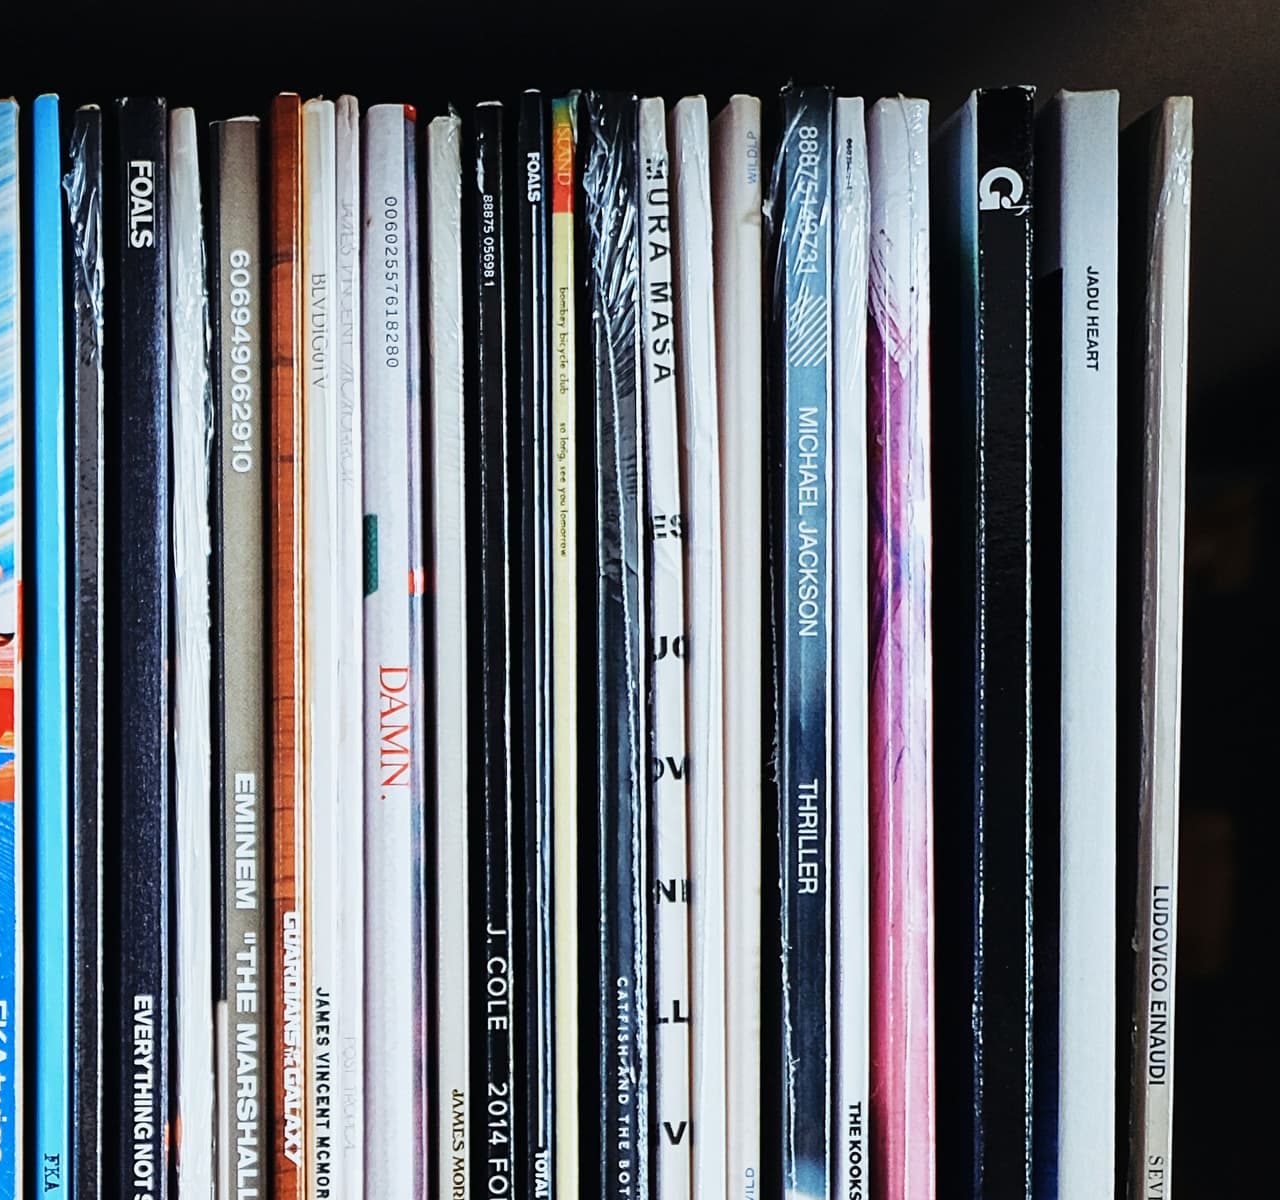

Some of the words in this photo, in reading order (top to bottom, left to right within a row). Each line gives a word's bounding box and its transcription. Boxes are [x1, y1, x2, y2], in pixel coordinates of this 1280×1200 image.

[130, 161, 152, 247] FOALS
[385, 197, 399, 367] 00602557618280
[1087, 266, 1099, 310] JADU
[231, 250, 251, 471] 606949062910
[1087, 316, 1099, 371] HEART
[799, 407, 817, 514] MICHAEL
[799, 520, 817, 635] JACKSON
[380, 665, 410, 800] DAMN.
[487, 922, 507, 944] J.
[1151, 885, 1169, 992] LUDOVICO
[316, 987, 330, 1046] JAMES
[488, 957, 507, 1030] COLE
[1149, 1000, 1167, 1085] EINAUDI
[316, 1052, 330, 1129] VINCENT
[850, 1103, 861, 1136] THE
[45, 1154, 59, 1192] FKA
[849, 1140, 862, 1200] KOOKS
